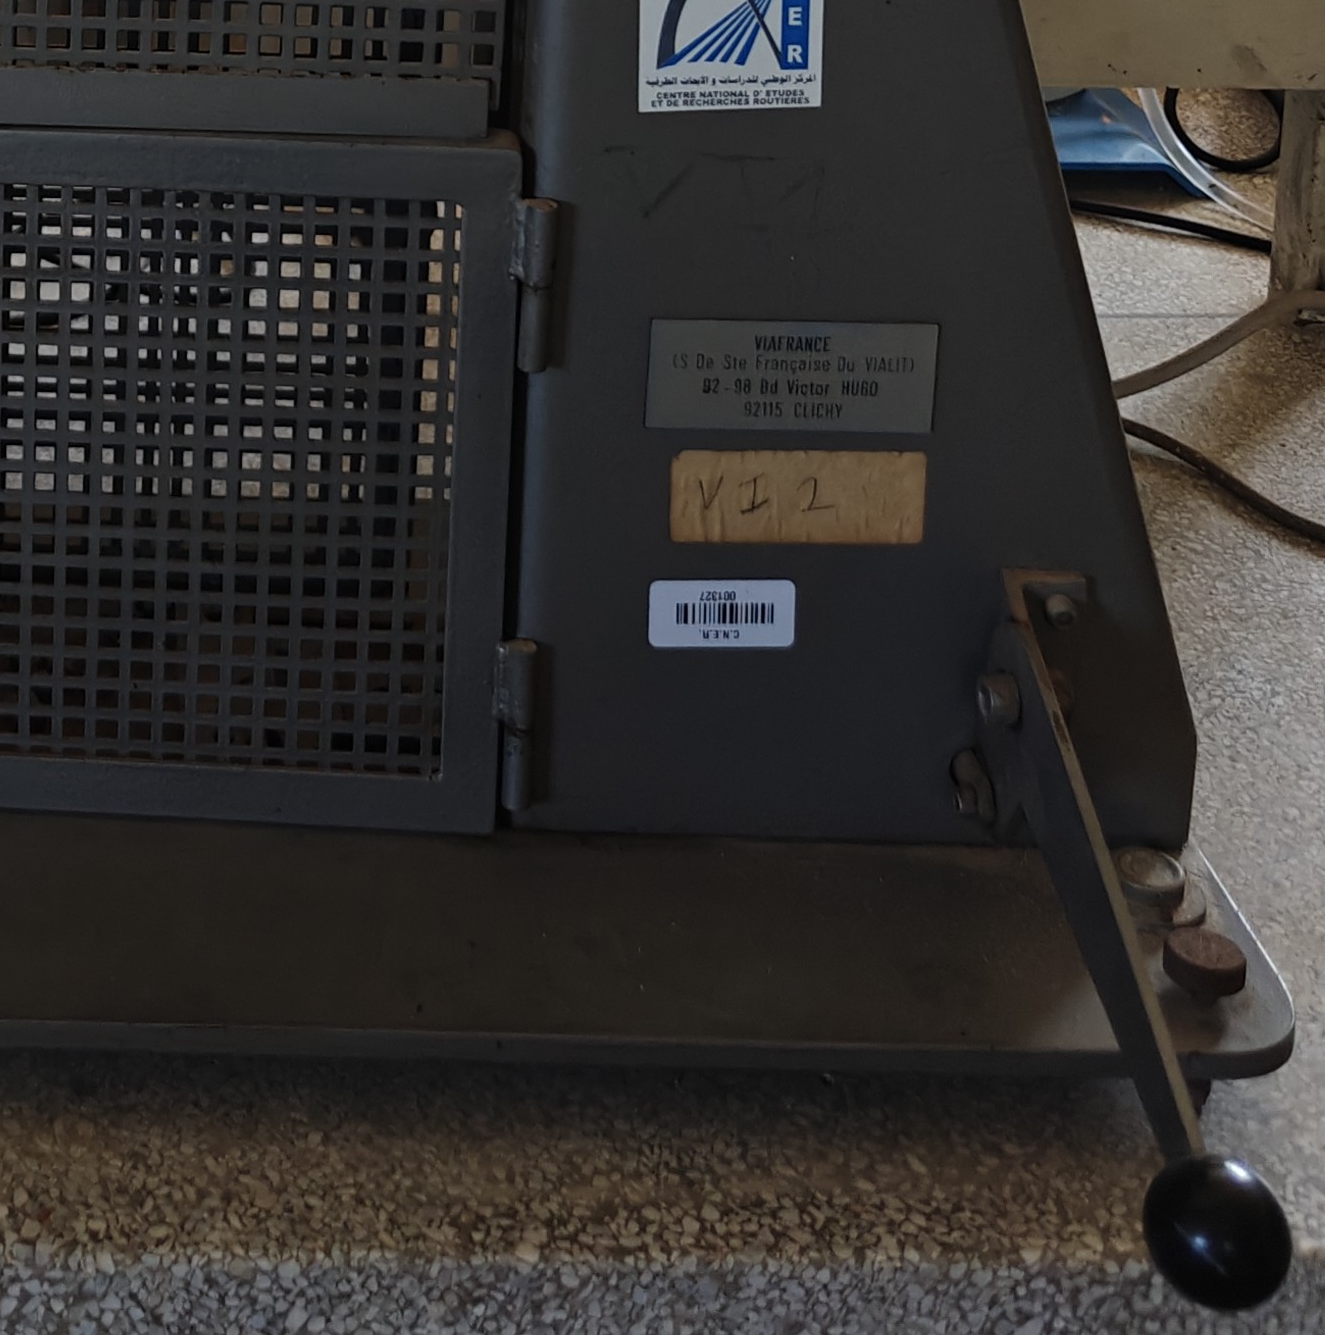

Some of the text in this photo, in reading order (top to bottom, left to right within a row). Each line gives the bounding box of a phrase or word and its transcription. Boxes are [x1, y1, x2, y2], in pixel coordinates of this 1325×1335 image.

[651, 100, 664, 108] ET
[666, 99, 679, 107] DE
[682, 98, 750, 106] RECHERCHES
[656, 91, 696, 99] CENTRE
[699, 90, 750, 99] NATIONAL
[755, 335, 832, 353] VIAFRANCE
[696, 353, 715, 370] De
[723, 354, 748, 371] Ste
[755, 354, 831, 375] Française
[837, 356, 856, 373] Du
[760, 378, 779, 396] Bd
[786, 379, 830, 398] Victor
[841, 380, 879, 397] HUGO
[743, 401, 844, 419] 92115 CLICHY
[700, 590, 737, 602] 001327
